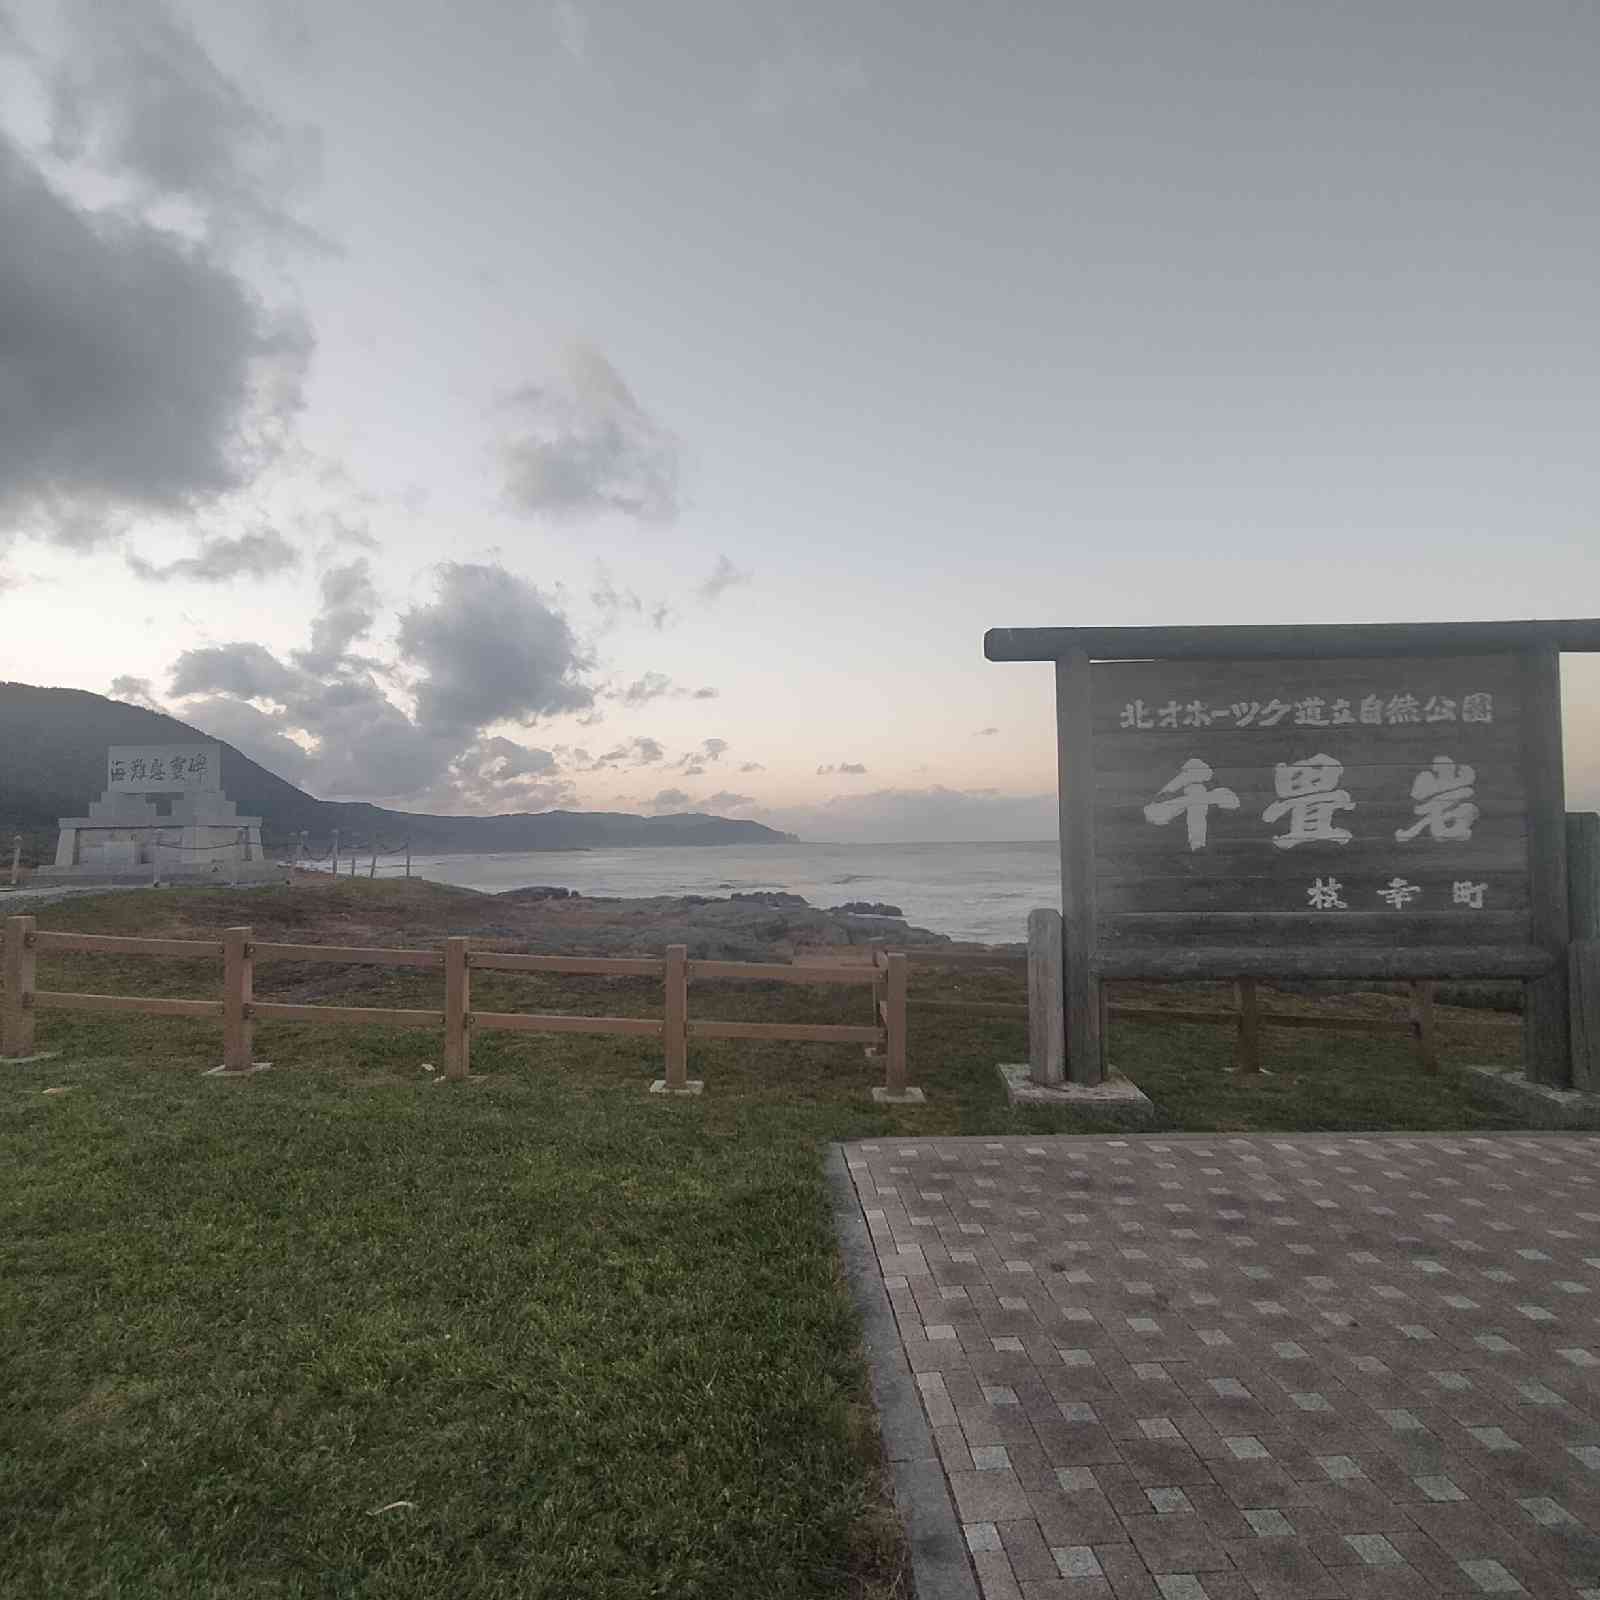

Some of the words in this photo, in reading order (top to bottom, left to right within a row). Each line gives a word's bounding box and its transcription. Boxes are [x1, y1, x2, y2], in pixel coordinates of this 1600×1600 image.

[1143, 752, 1481, 851] 千畳岩
[1306, 876, 1489, 910] 枝幸町
